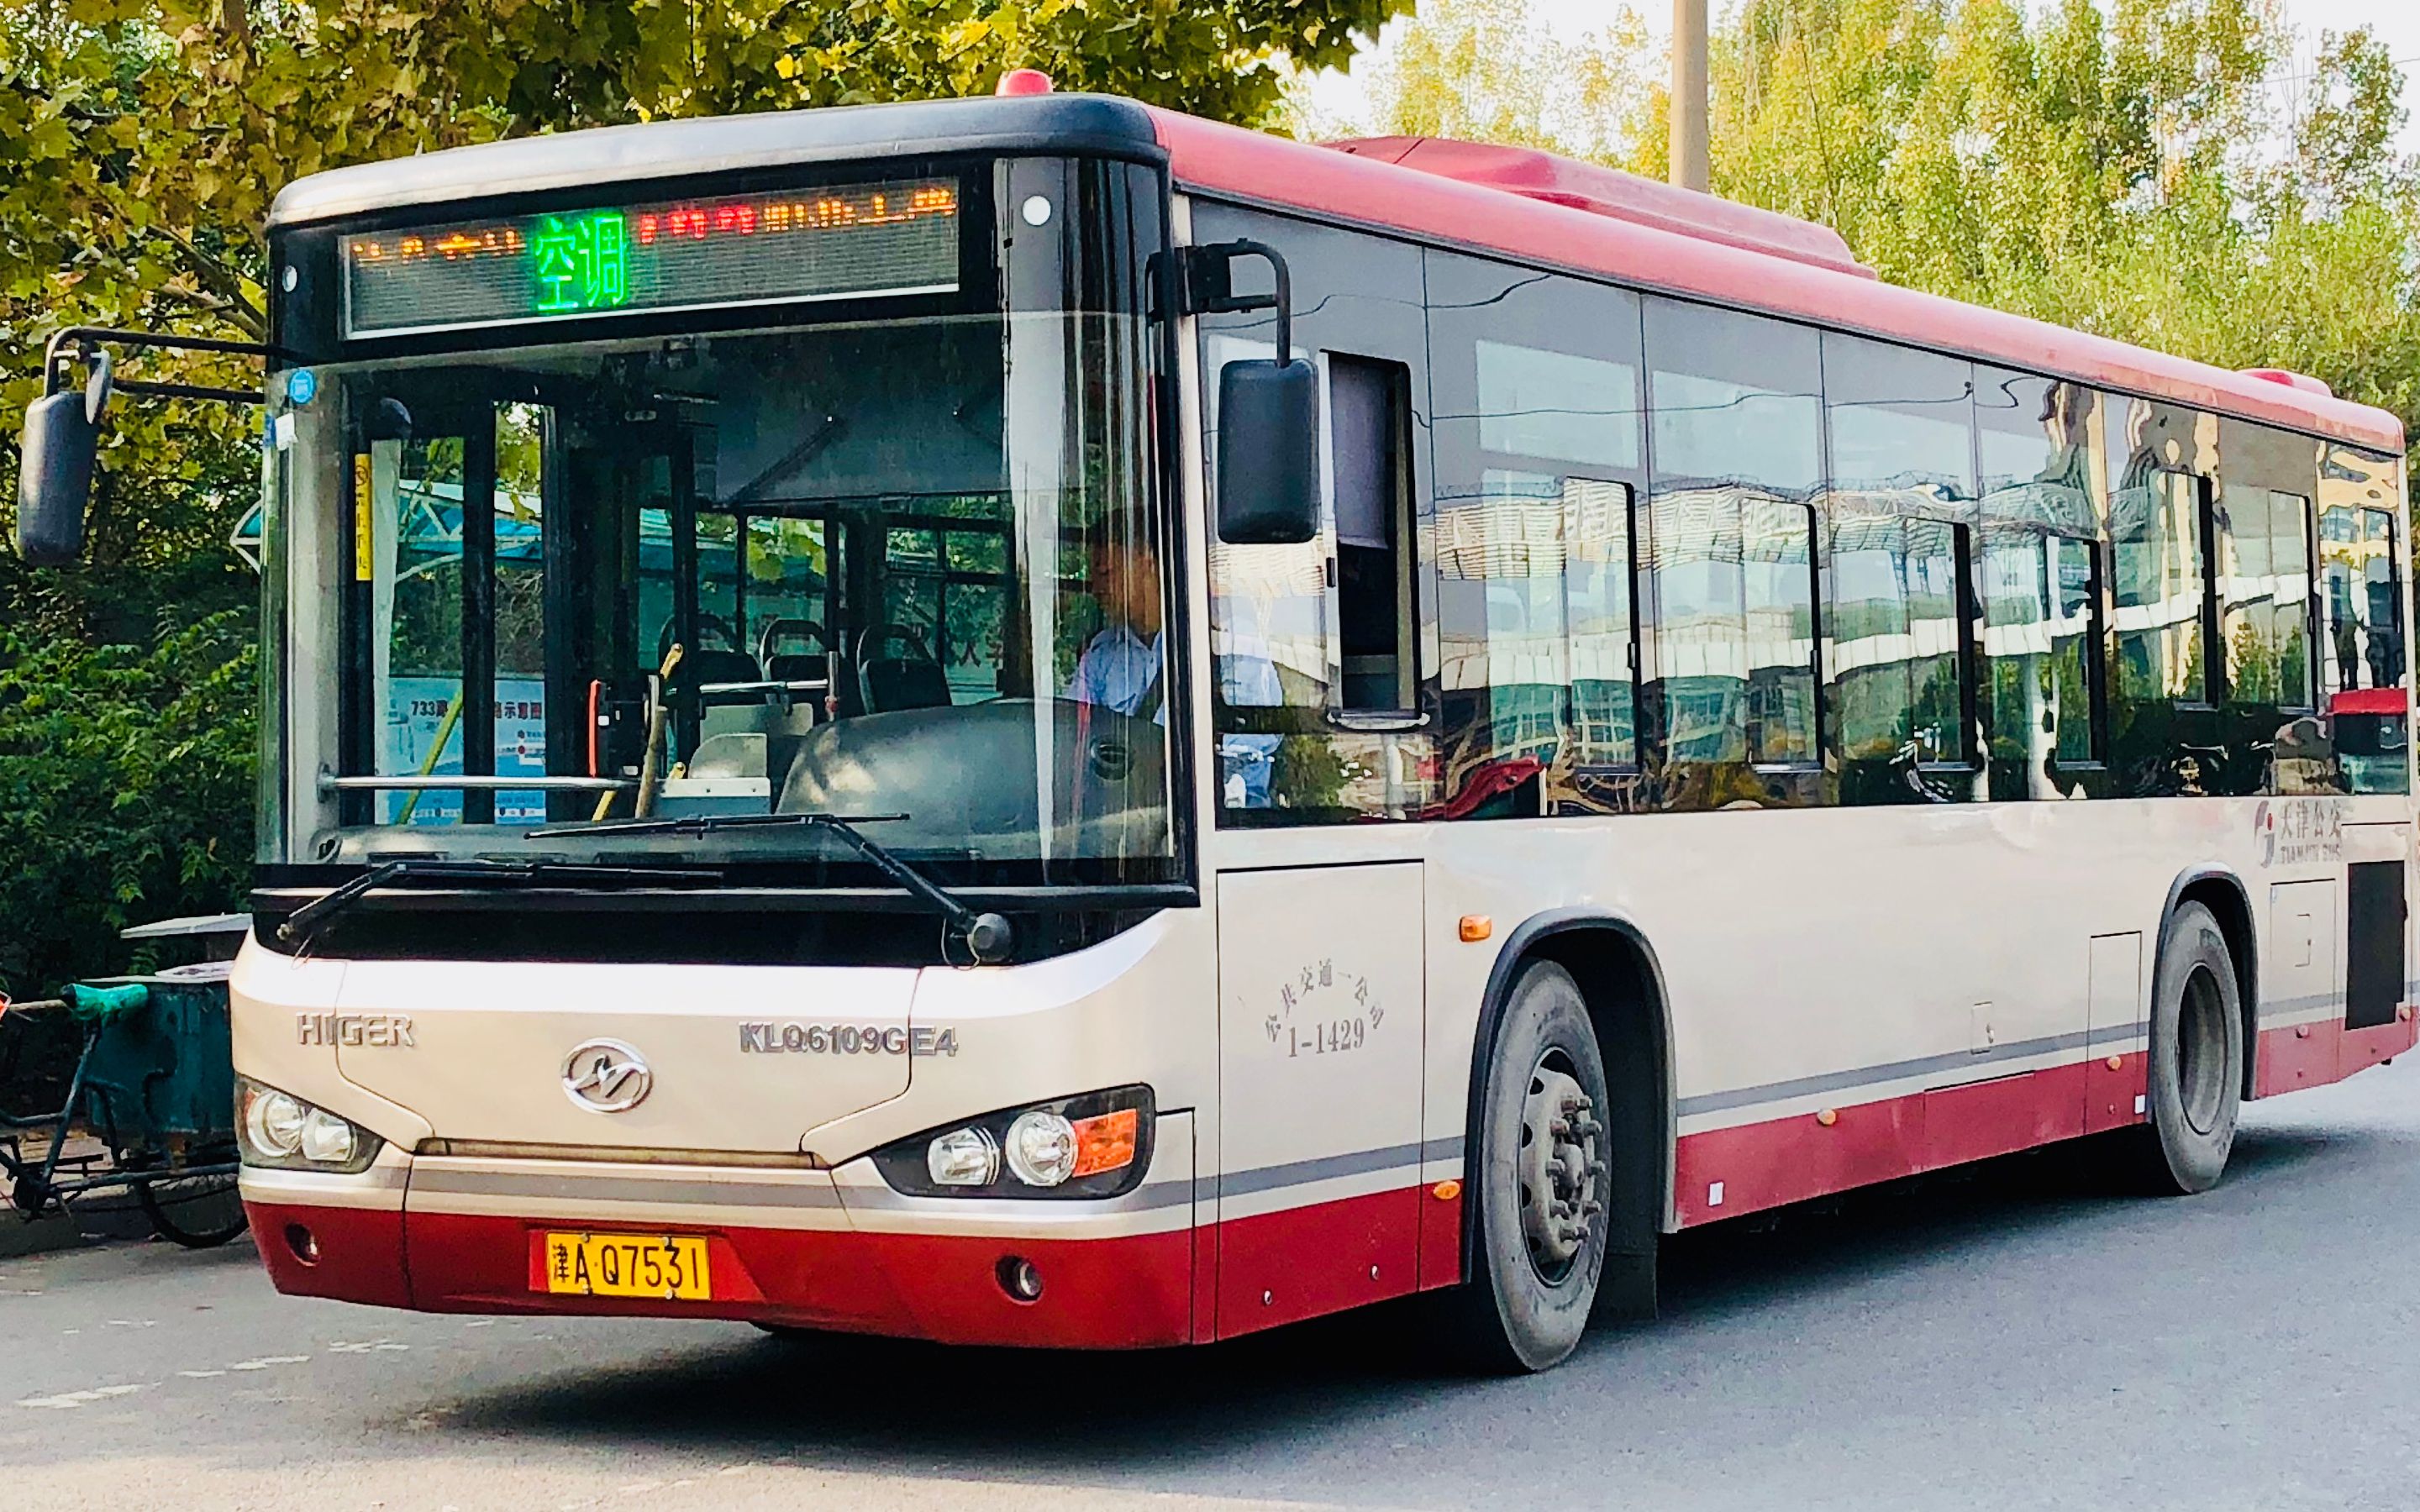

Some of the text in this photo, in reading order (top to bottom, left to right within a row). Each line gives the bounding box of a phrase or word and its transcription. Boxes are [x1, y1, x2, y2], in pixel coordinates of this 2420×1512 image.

[534, 216, 627, 313] 空调
[2280, 799, 2341, 839] 天津公交
[296, 1011, 415, 1047] HIGER
[739, 1021, 959, 1058] KLQ6109GE4
[1288, 1017, 1365, 1057] 1-1429
